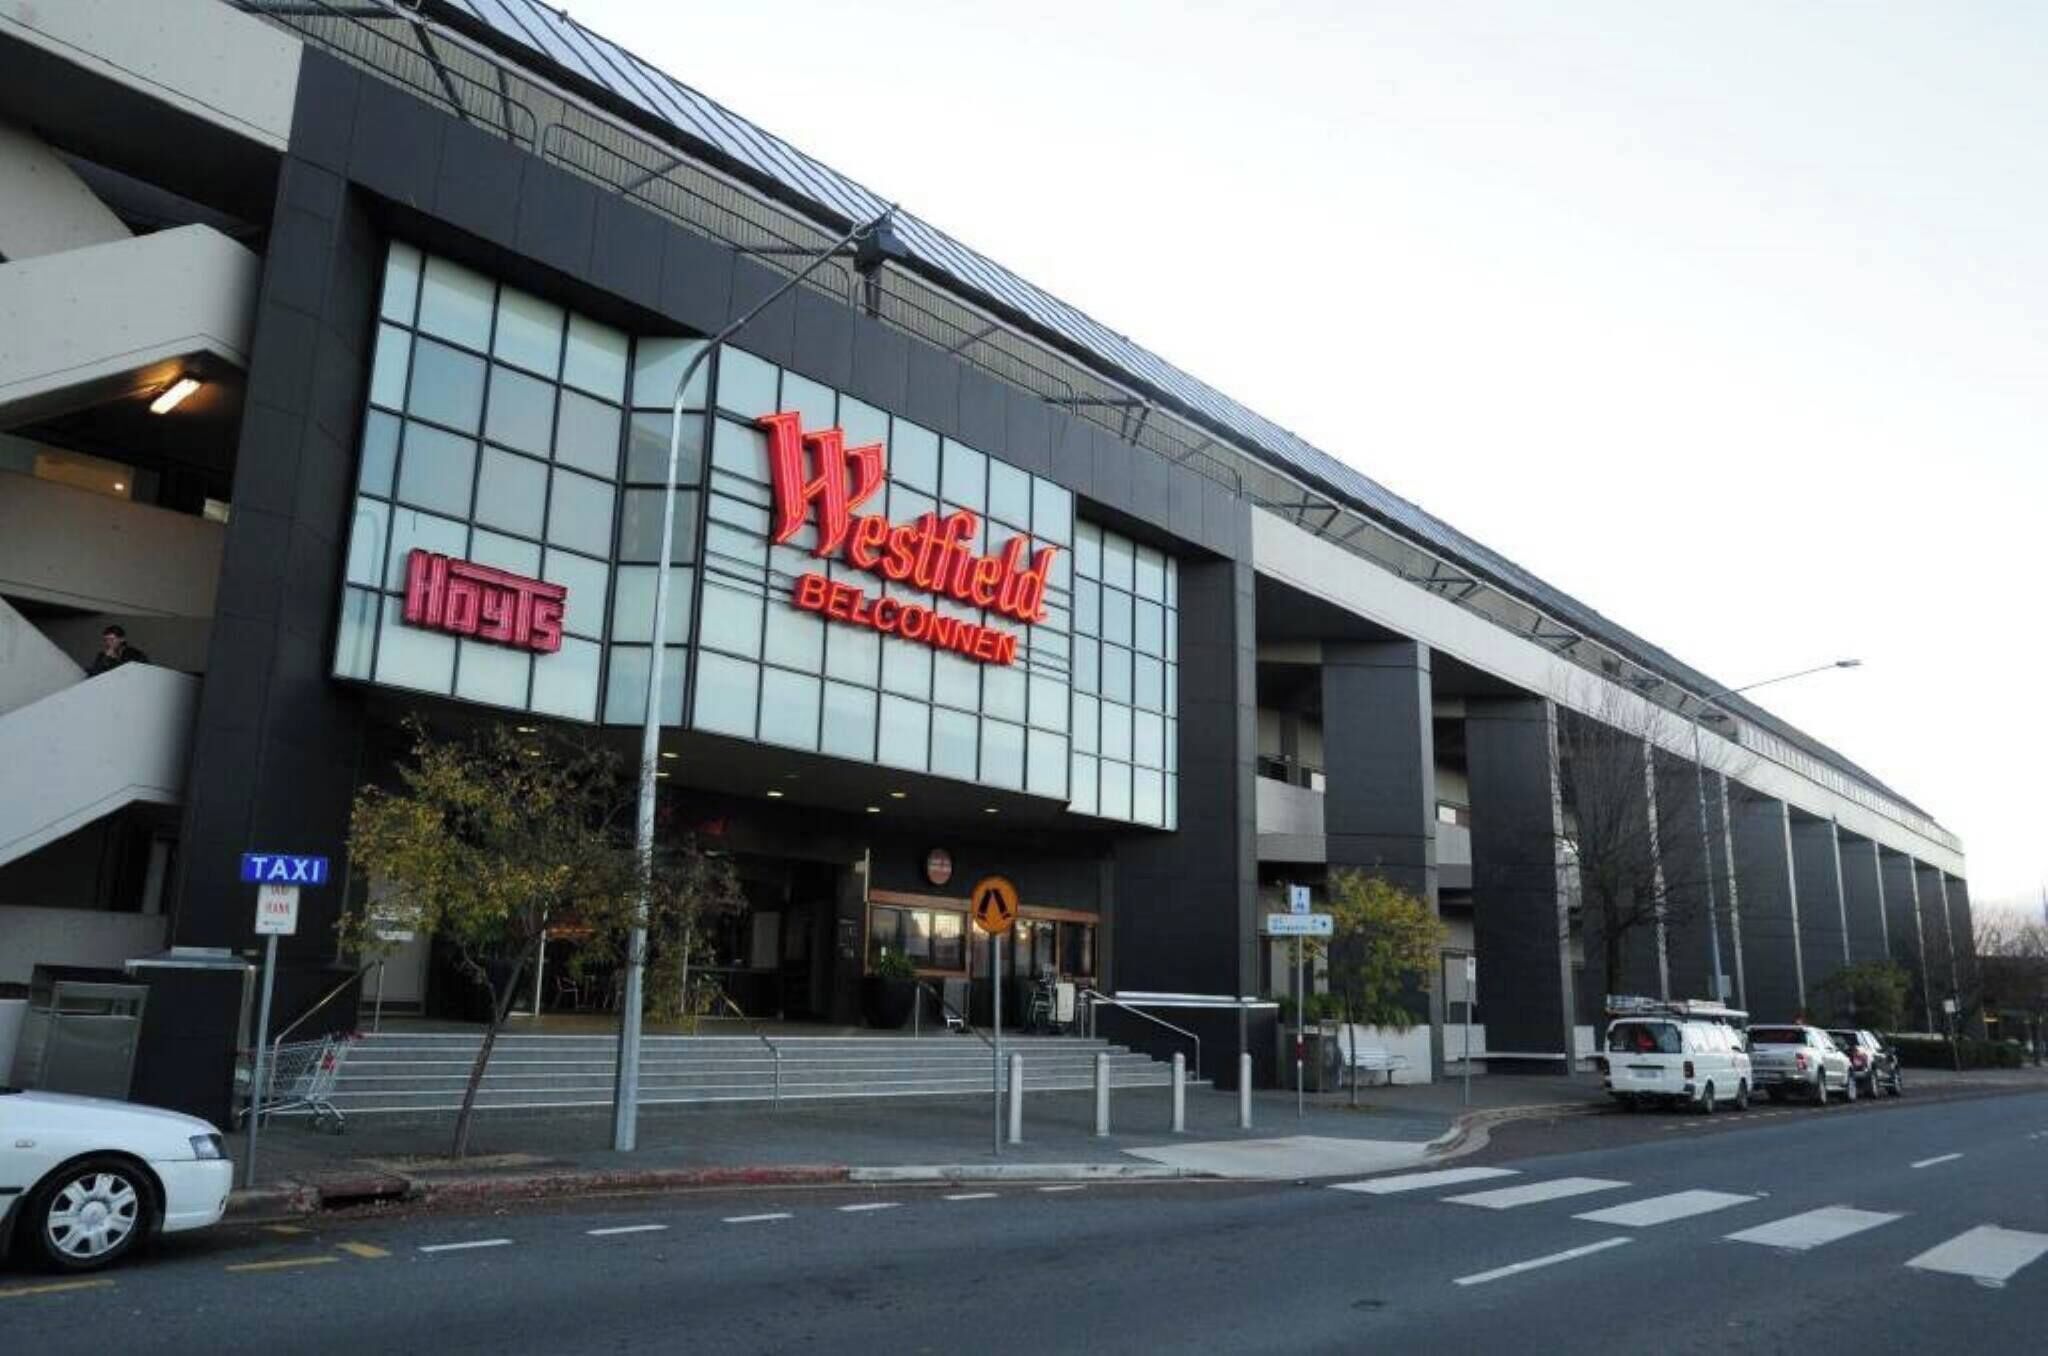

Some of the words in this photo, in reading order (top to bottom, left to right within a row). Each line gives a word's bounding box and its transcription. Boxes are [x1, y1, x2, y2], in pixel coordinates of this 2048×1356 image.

[757, 411, 1055, 623] Westfield
[795, 572, 1017, 664] BELCONNEN
[251, 857, 320, 881] TAXI
